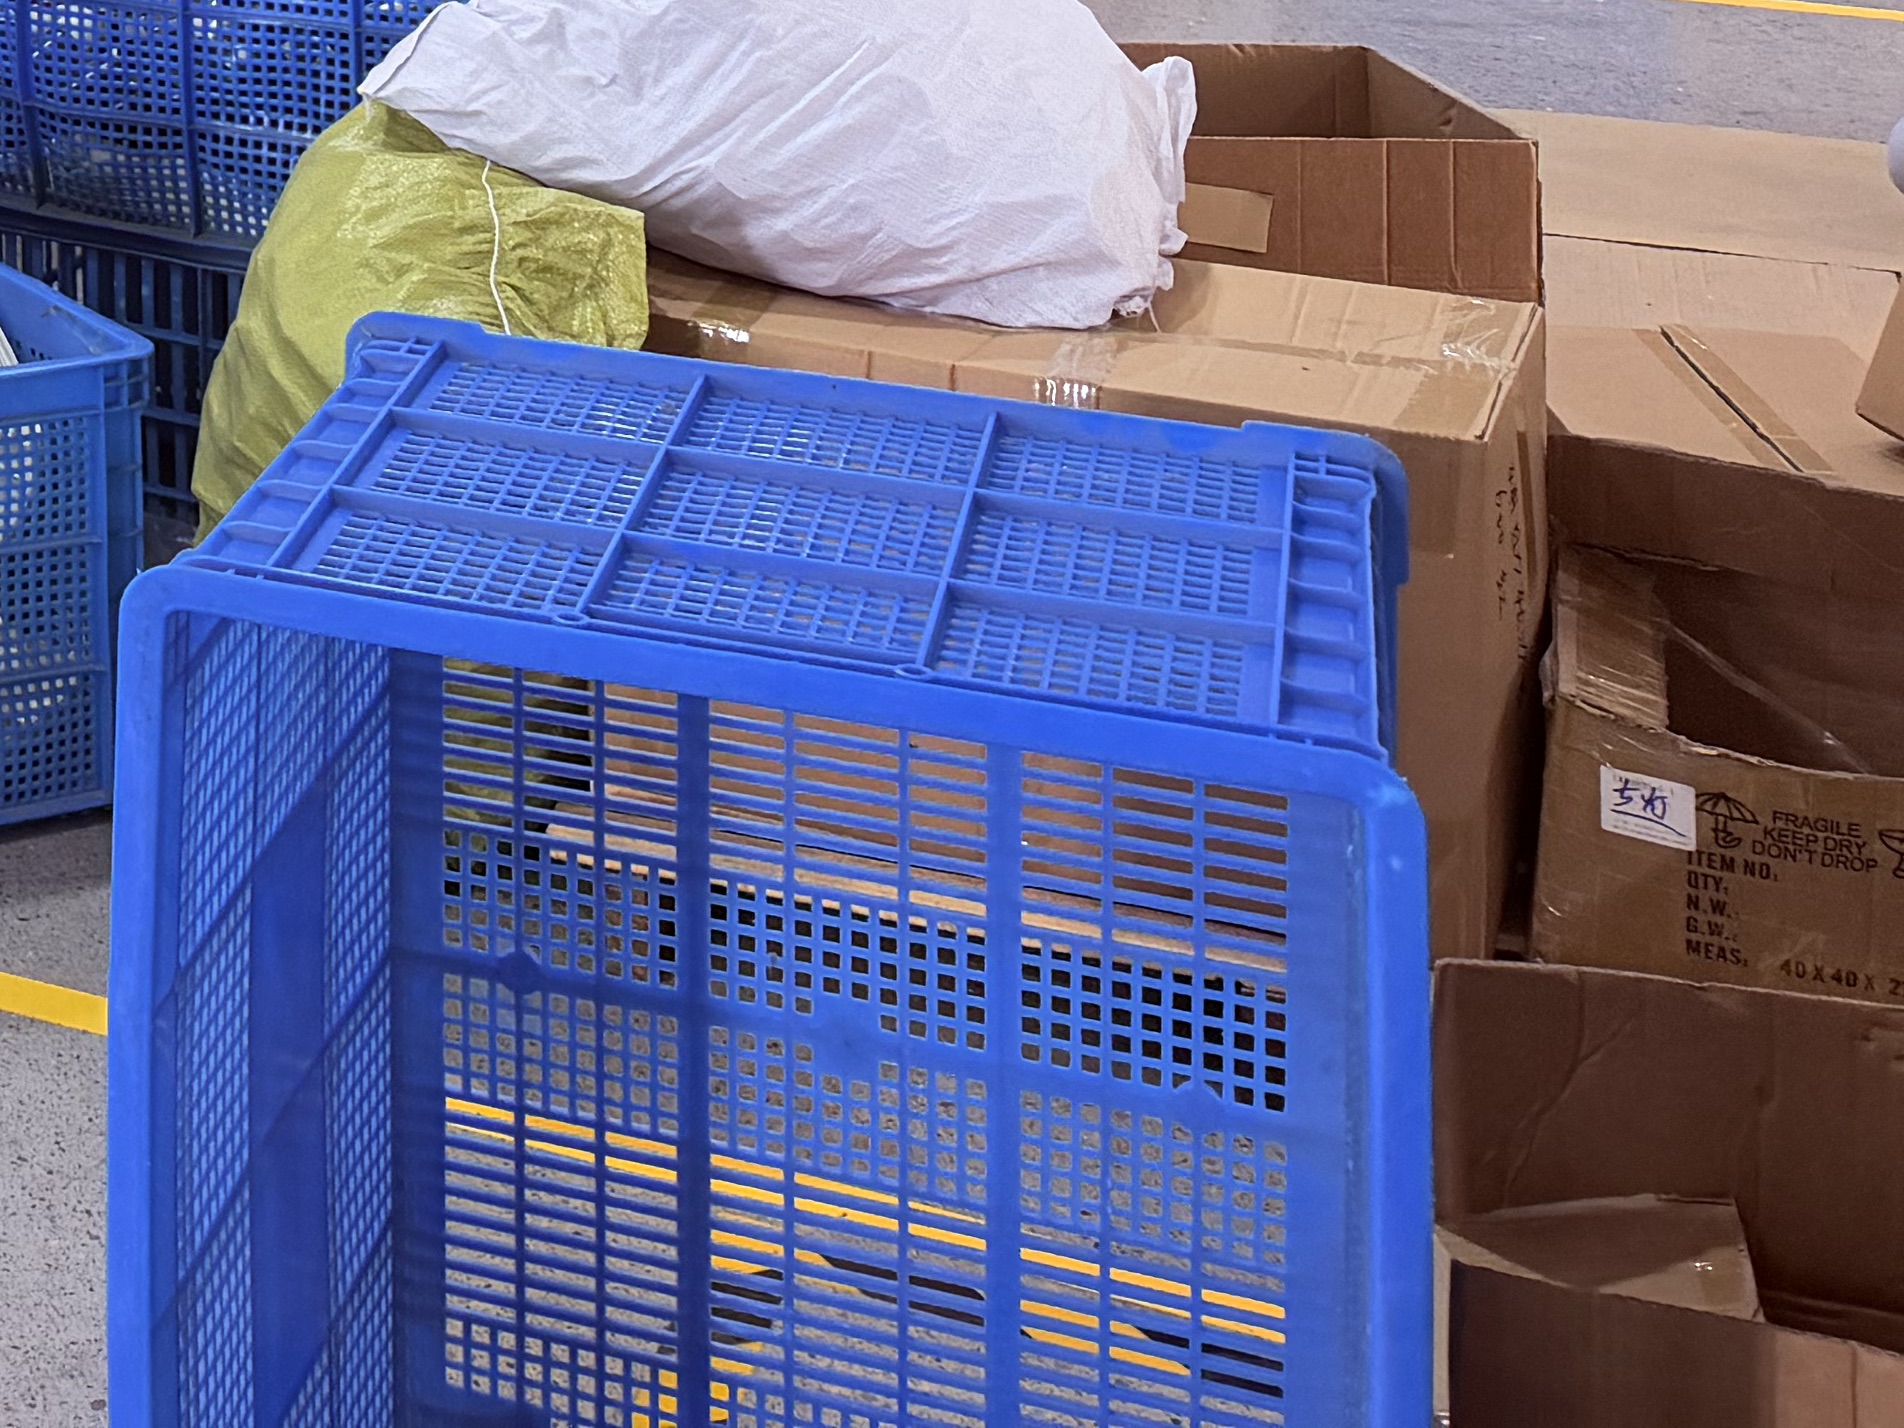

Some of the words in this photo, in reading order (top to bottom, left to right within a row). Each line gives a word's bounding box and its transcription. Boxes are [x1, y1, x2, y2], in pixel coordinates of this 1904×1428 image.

[1772, 810, 1862, 838] FRAGILE
[1763, 826, 1818, 847] KEEP
[1824, 836, 1867, 856] DRY
[1687, 849, 1736, 873] ITEM
[1752, 839, 1817, 865] DON'T
[1821, 852, 1878, 873] DROP
